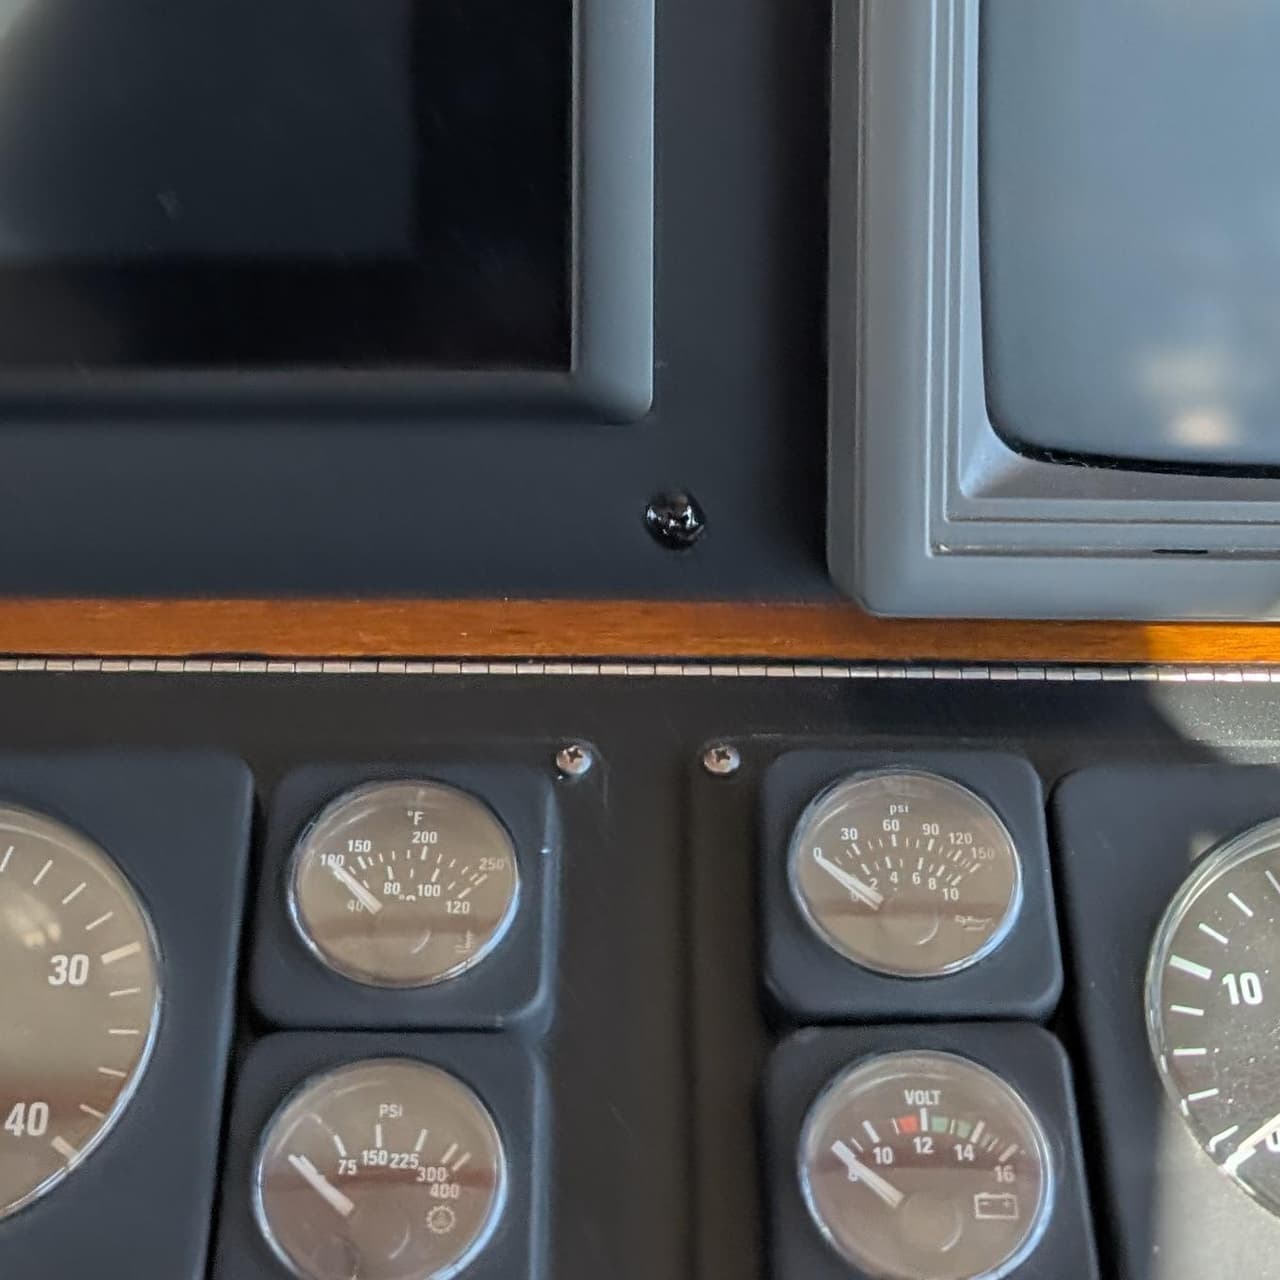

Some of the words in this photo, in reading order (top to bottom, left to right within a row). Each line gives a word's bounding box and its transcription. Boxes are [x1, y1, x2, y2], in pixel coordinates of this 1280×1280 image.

[889, 803, 909, 815] psi
[883, 819, 900, 832] 60
[922, 823, 940, 835] 90
[412, 831, 437, 844] 200
[841, 828, 858, 841] 30
[949, 832, 972, 845] 120
[347, 839, 371, 852] 150
[971, 847, 995, 860] 150
[479, 858, 504, 870] 250
[890, 871, 898, 884] 4
[912, 872, 921, 885] 6
[928, 878, 936, 890] 8
[384, 882, 400, 895] 80
[417, 885, 440, 897] 100
[942, 888, 959, 901] 10
[445, 901, 470, 914] 120
[48, 955, 89, 985] 30
[1221, 972, 1263, 1006] 10
[904, 1090, 941, 1105] VOLT
[379, 1104, 403, 1118] PSI
[4, 1103, 49, 1137] 40
[913, 1136, 934, 1154] 12
[362, 1150, 388, 1165] 150
[873, 1147, 893, 1164] 10
[954, 1144, 974, 1161] 14
[338, 1160, 357, 1175] 75
[390, 1154, 419, 1169] 225
[416, 1167, 446, 1182] 300
[994, 1166, 1015, 1183] 16
[430, 1183, 459, 1198] 400
